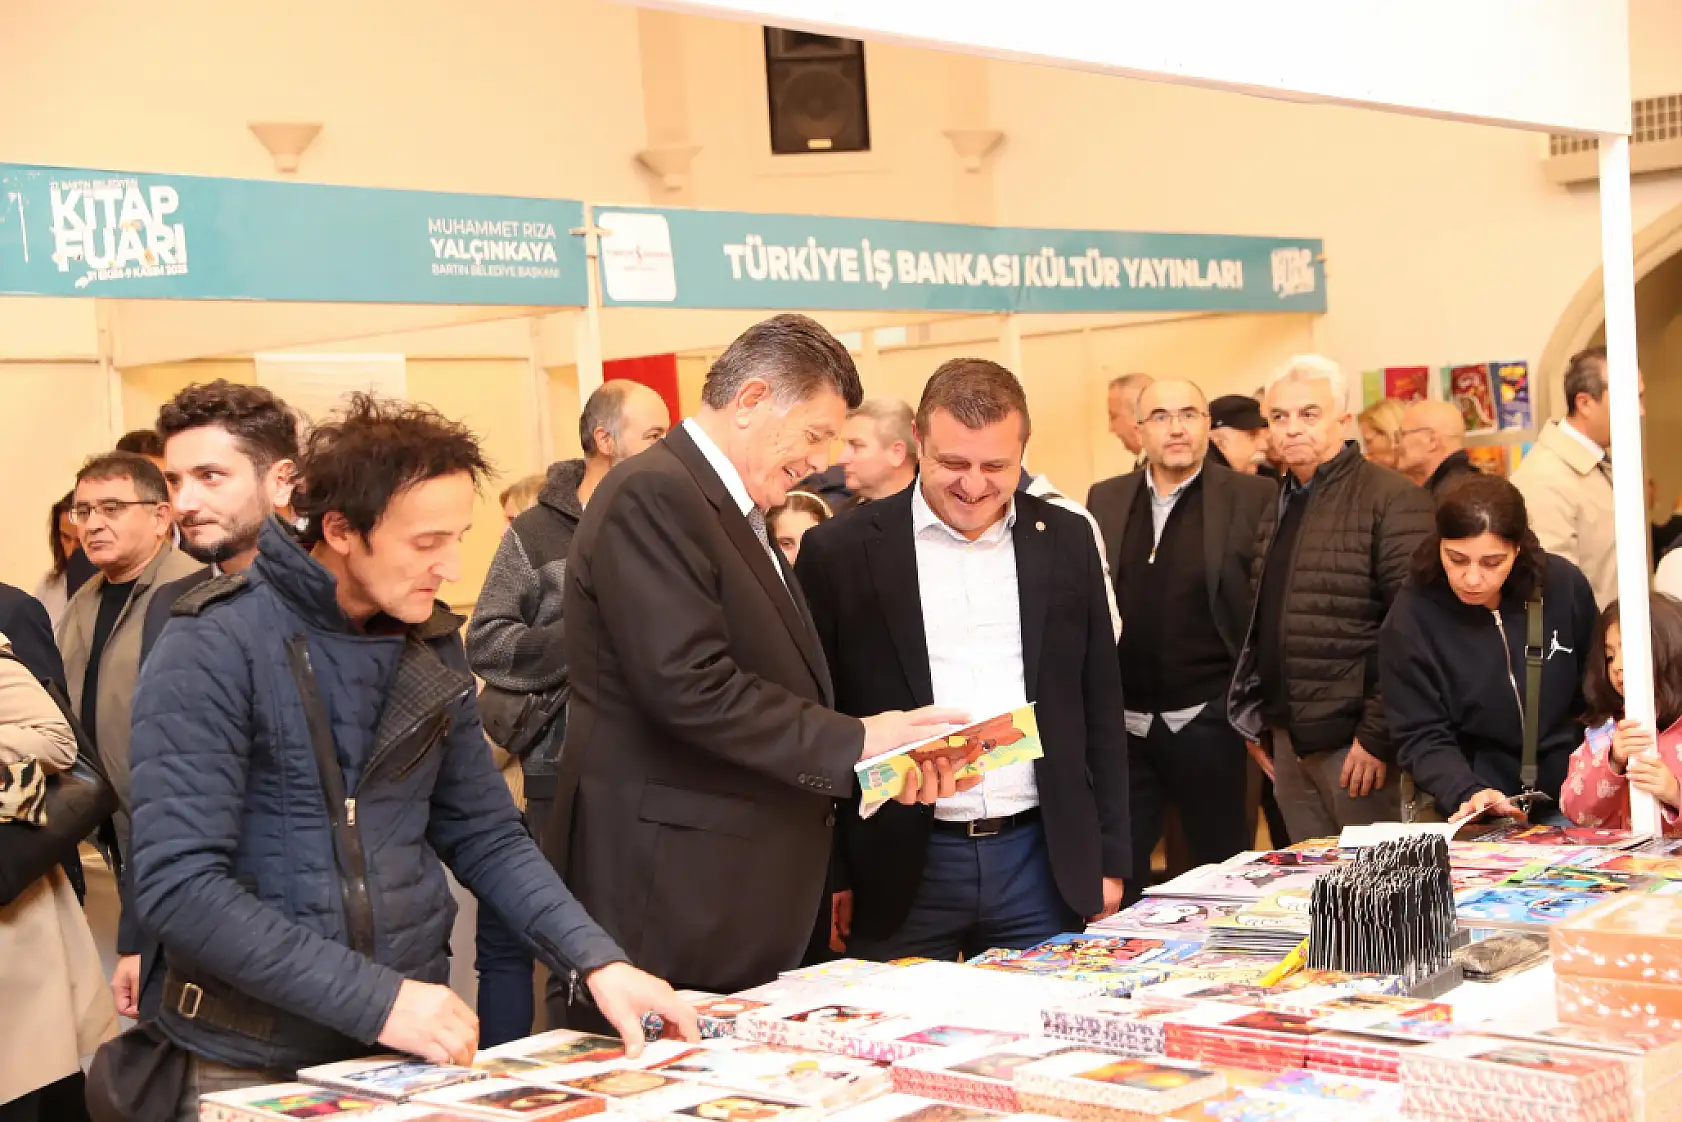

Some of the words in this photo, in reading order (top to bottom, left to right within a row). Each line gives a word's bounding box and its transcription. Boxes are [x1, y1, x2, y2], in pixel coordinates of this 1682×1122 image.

[50, 184, 179, 230] KİTAP
[428, 216, 519, 238] MUHAMMET
[523, 221, 556, 239] RIZA
[53, 222, 187, 272] FUARI
[429, 237, 558, 265] YALÇINKAYA
[723, 233, 860, 282] TÜRKİYE
[861, 237, 894, 290] İŞ
[896, 250, 1020, 287] BANKASI
[1023, 246, 1121, 289] KÜLTÜR
[1121, 256, 1243, 291] YAYINLARI
